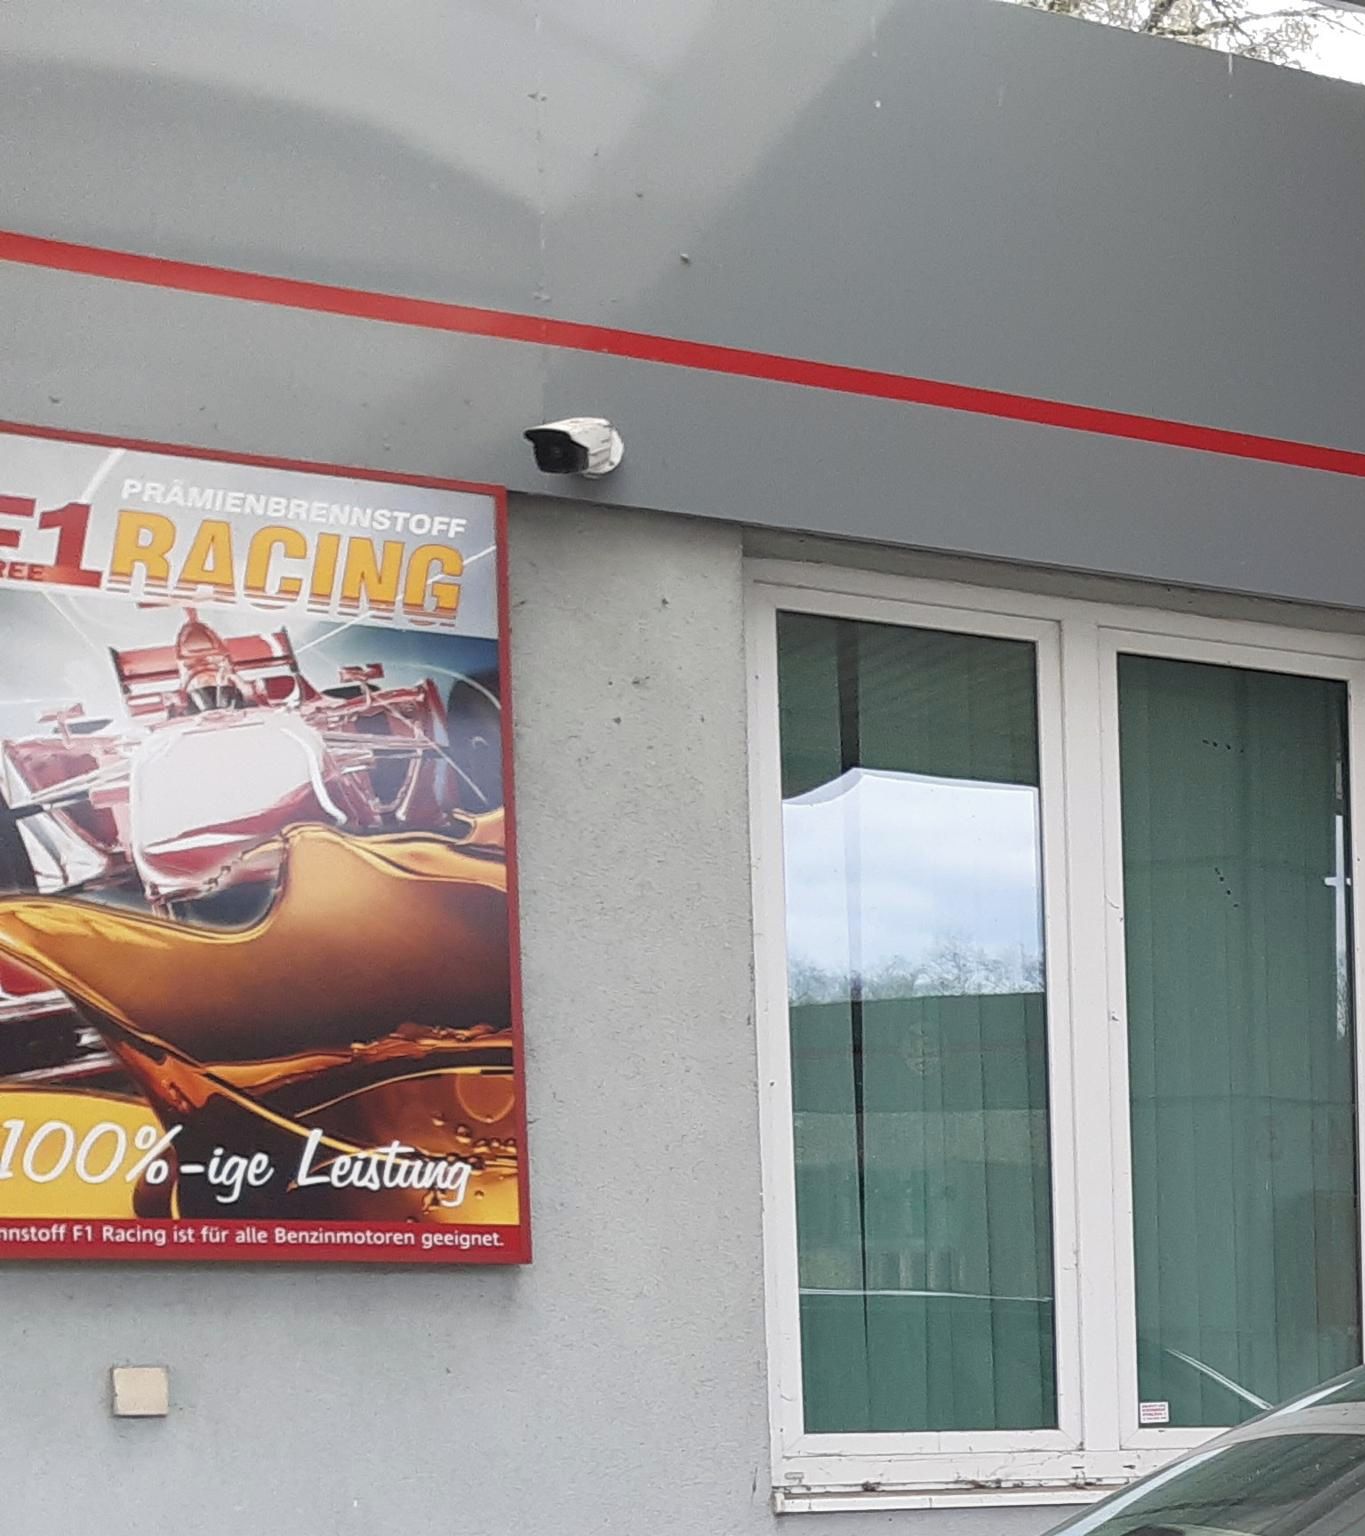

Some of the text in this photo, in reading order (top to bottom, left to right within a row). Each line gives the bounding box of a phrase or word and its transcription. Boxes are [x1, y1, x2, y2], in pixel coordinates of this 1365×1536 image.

[105, 509, 465, 627] RACING
[297, 1128, 472, 1208] Leistung
[72, 1224, 93, 1243] F1
[102, 1225, 167, 1246] Racing
[172, 1225, 195, 1243] ist
[200, 1225, 229, 1244] für
[235, 1226, 268, 1244] alle
[274, 1227, 415, 1246] Benzinmotoren
[421, 1229, 504, 1250] geeignet.
